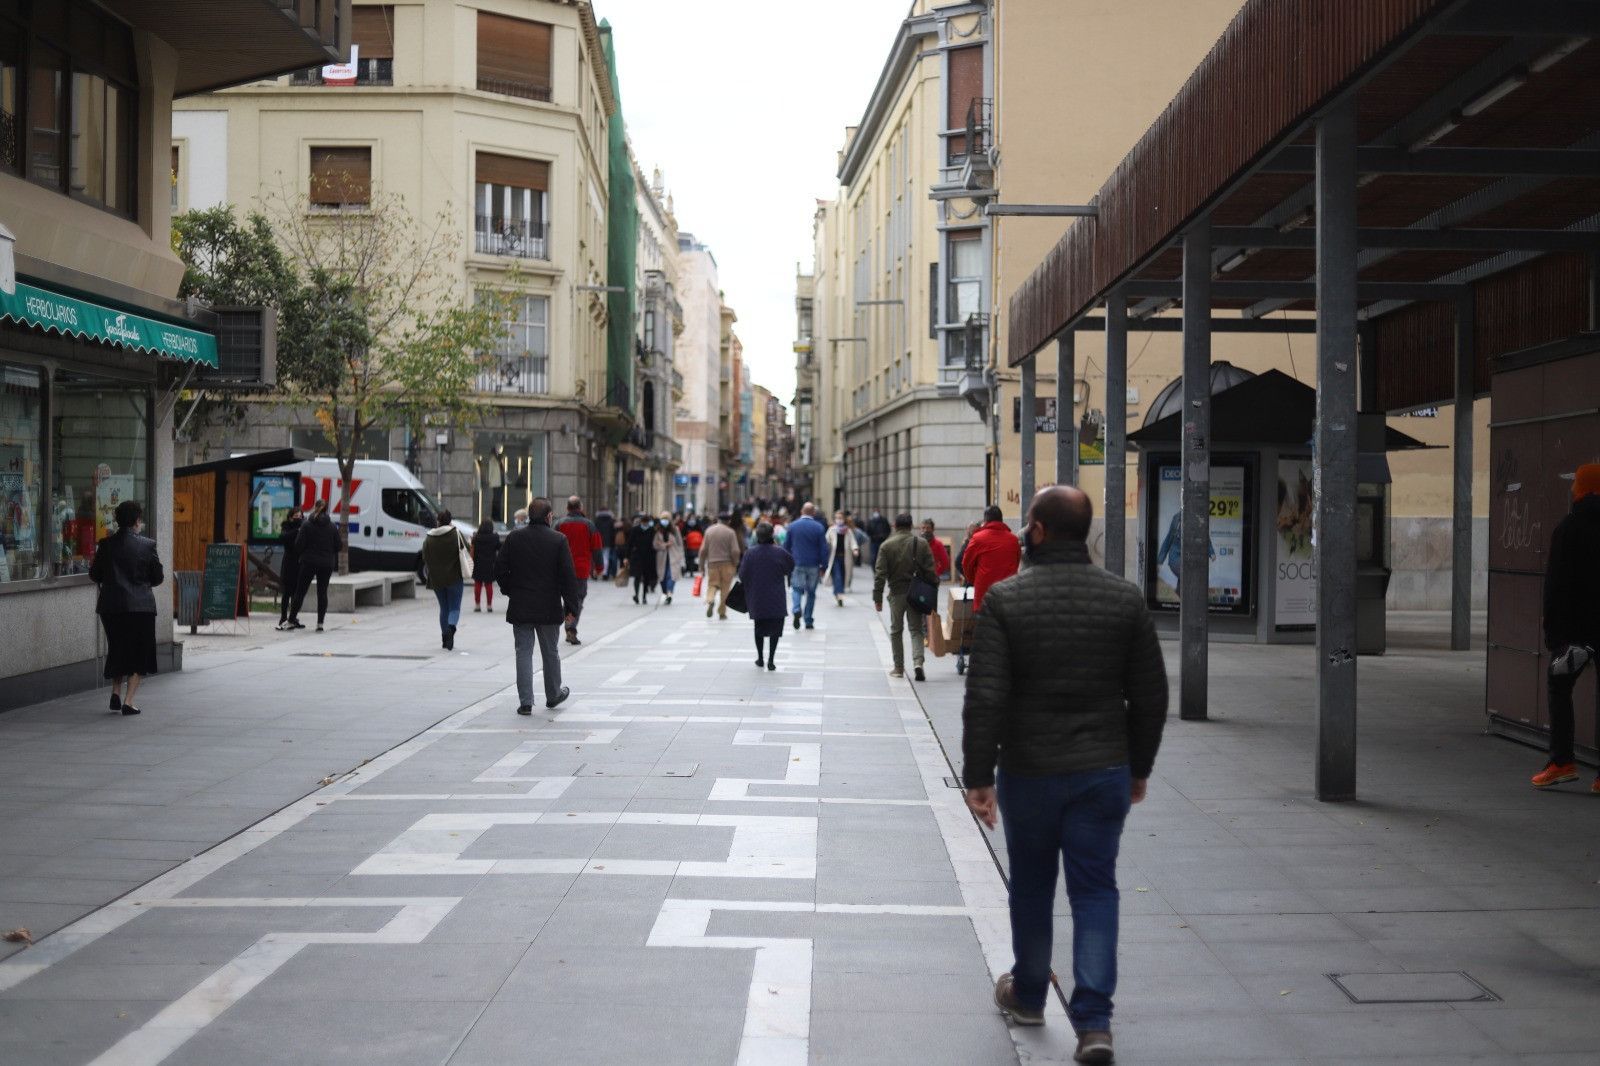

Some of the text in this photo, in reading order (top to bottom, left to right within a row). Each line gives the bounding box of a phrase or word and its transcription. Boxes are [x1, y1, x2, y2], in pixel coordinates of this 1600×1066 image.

[25, 296, 78, 326] HERBOLARIOS
[162, 331, 198, 354] HERBOLARIOS
[1278, 562, 1315, 580] SOCI
